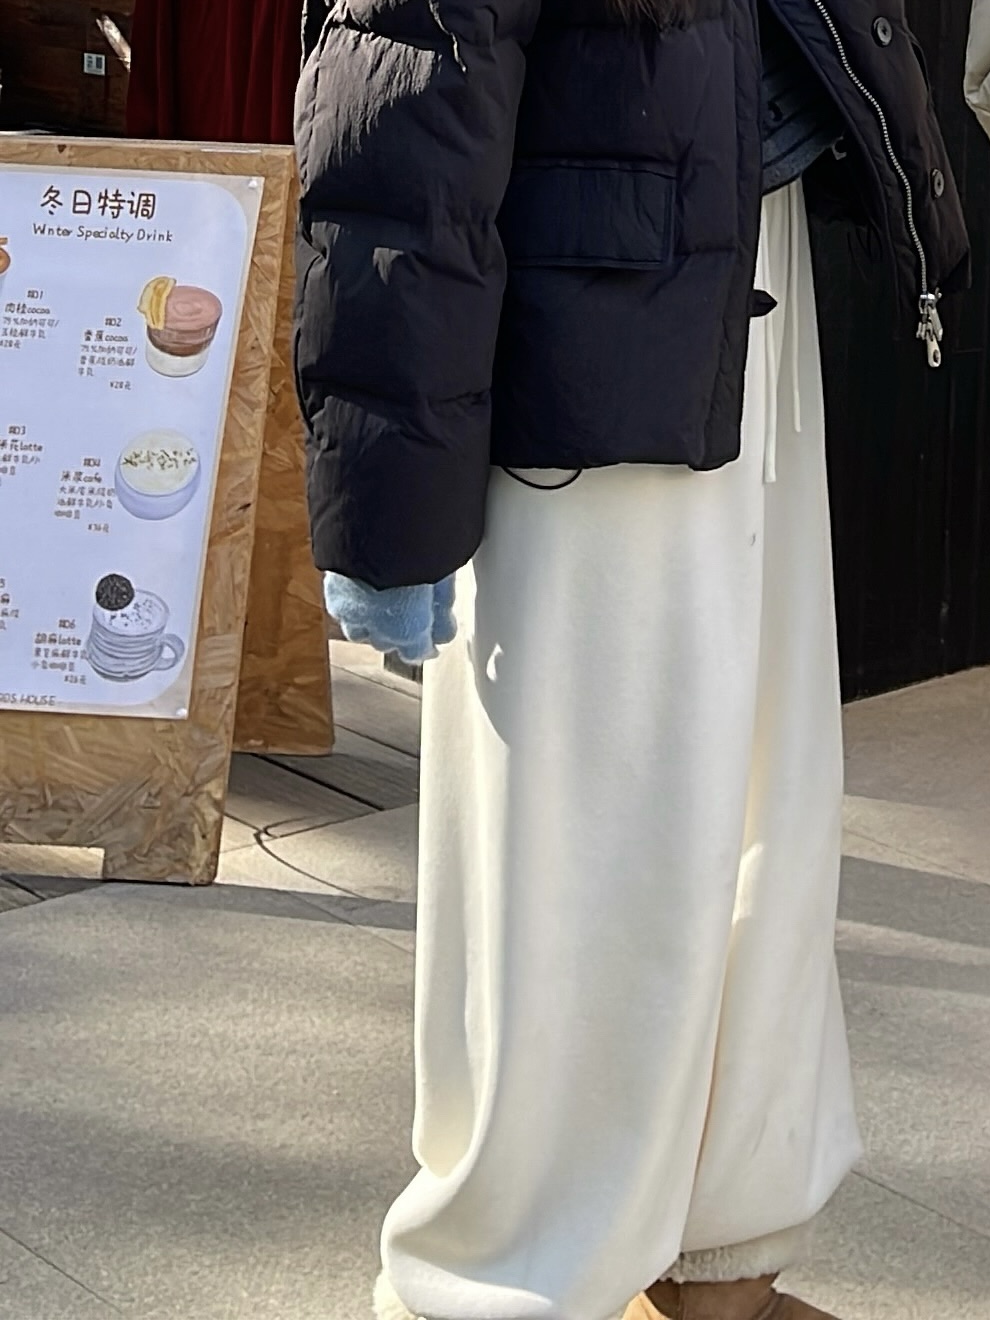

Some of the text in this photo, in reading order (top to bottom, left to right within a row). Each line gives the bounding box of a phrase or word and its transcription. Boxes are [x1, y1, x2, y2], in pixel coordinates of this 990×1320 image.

[40, 184, 157, 220] 冬日特调
[77, 226, 134, 244] Specialty
[137, 228, 173, 242] Drink
